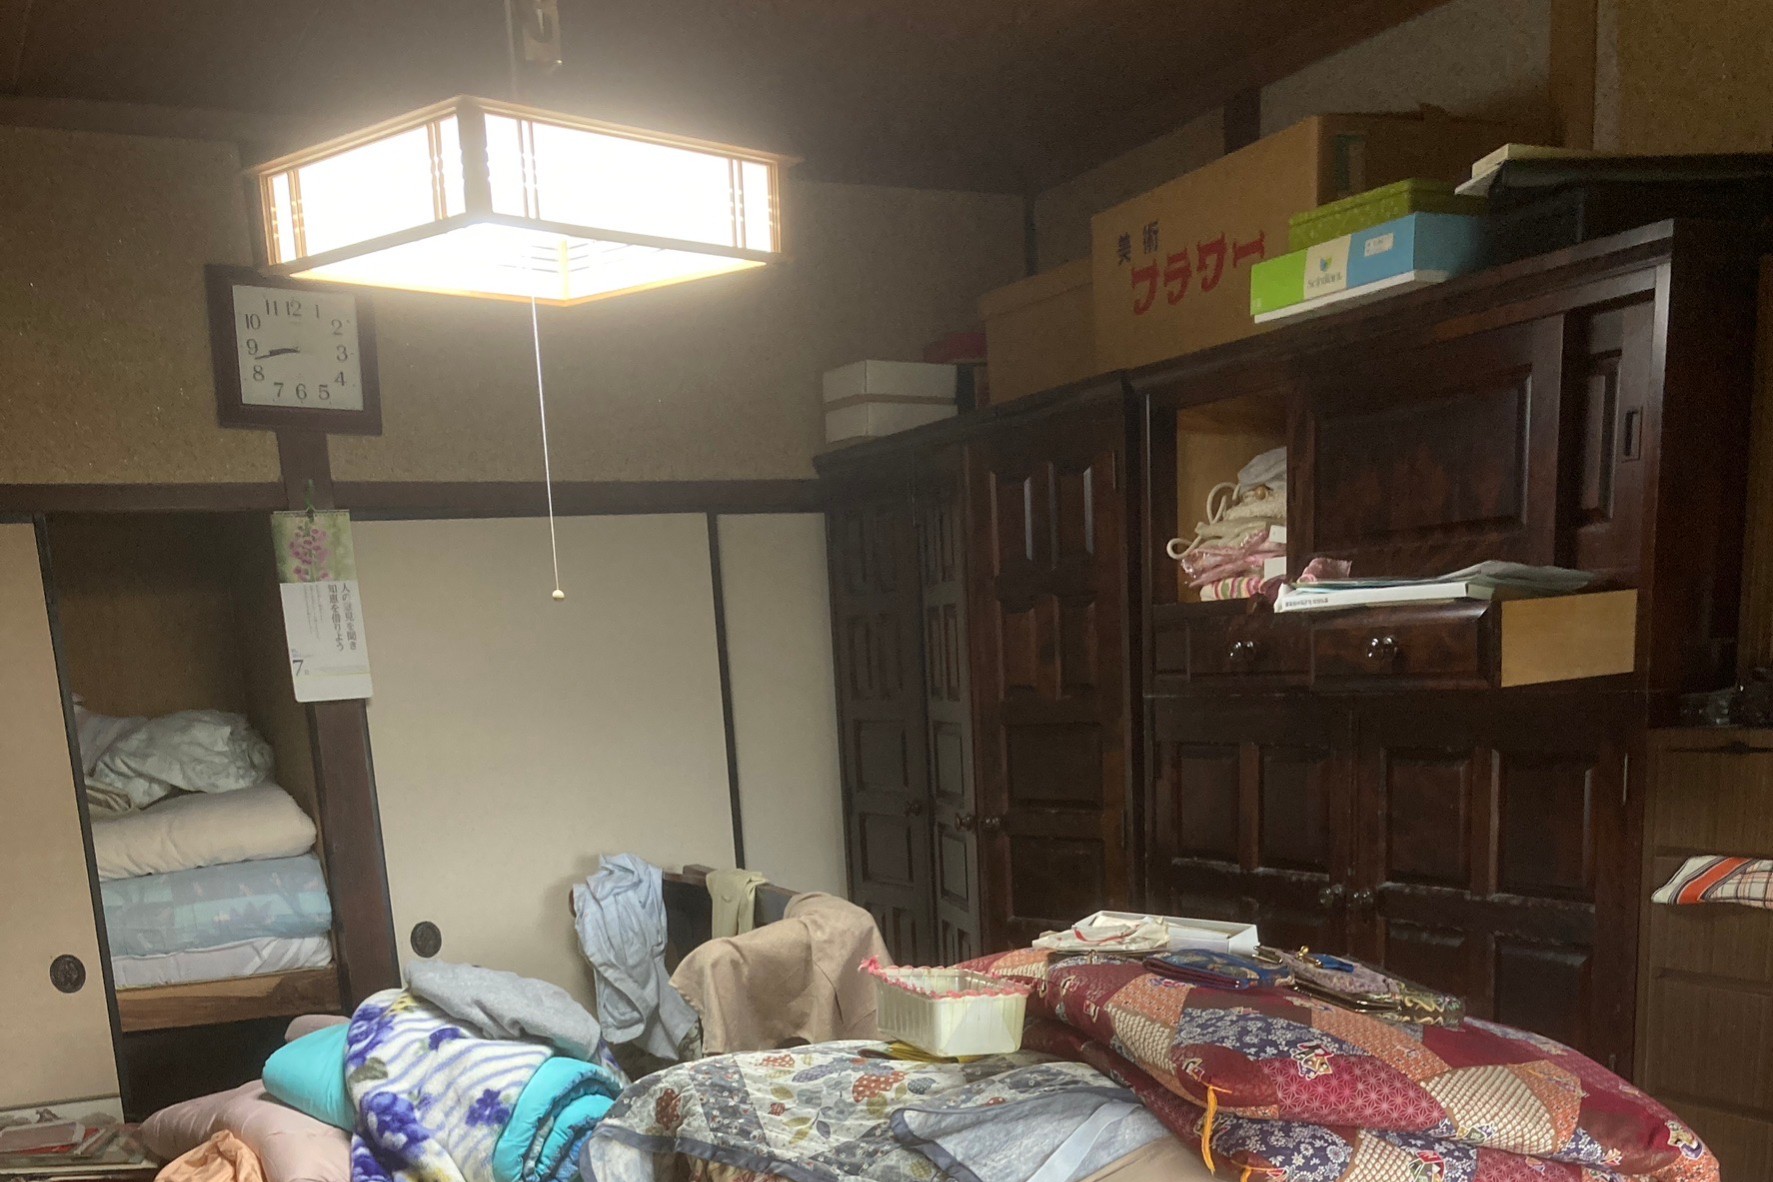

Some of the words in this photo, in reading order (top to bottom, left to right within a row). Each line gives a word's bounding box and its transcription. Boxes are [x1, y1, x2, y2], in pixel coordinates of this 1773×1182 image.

[1132, 229, 1265, 316] フラワー
[265, 299, 278, 316] 11
[286, 301, 302, 317] 12
[315, 304, 321, 318] 1
[245, 313, 261, 330] 10
[331, 319, 343, 335] 2
[246, 338, 258, 355] 9
[336, 345, 348, 362] 3
[252, 365, 265, 381] 8
[334, 371, 345, 386] 4
[273, 382, 284, 398] 7
[295, 383, 307, 400] 6
[318, 384, 330, 400] 5
